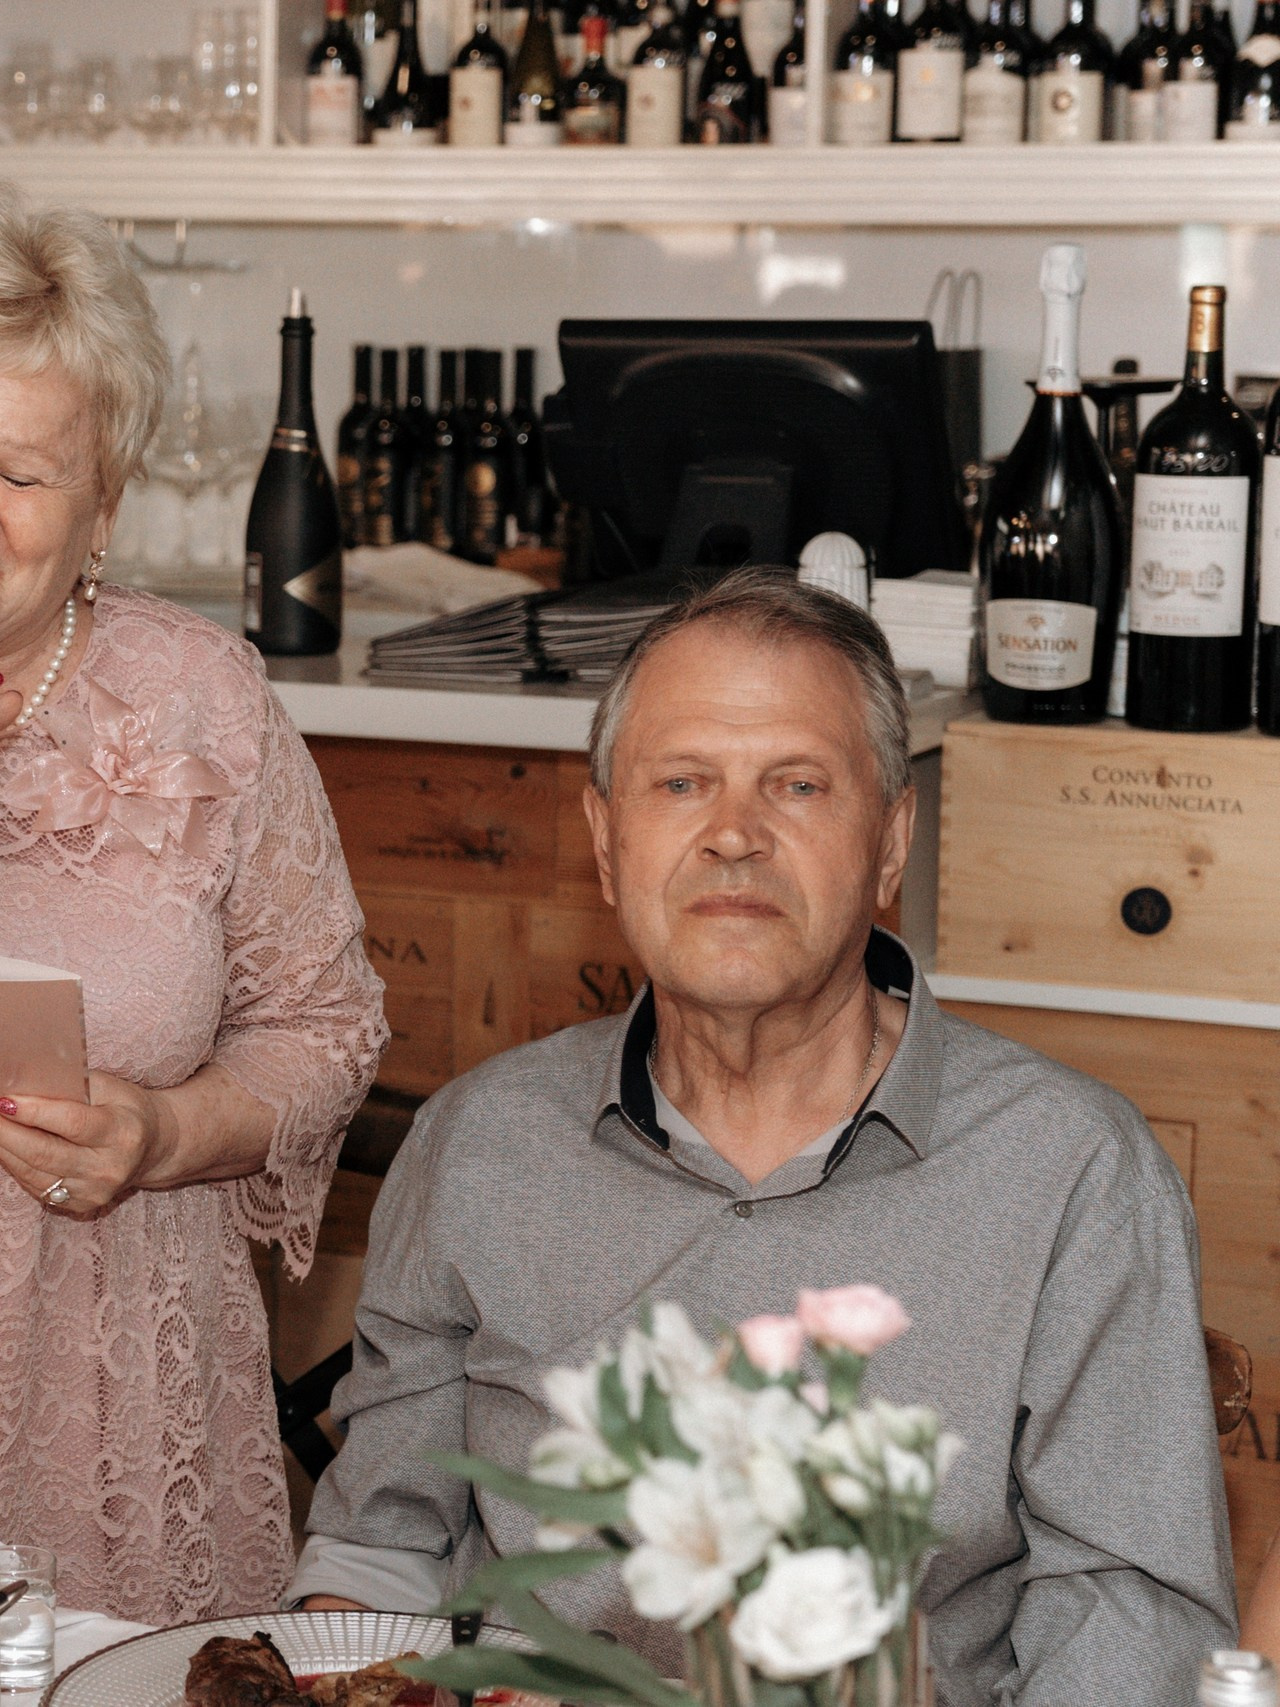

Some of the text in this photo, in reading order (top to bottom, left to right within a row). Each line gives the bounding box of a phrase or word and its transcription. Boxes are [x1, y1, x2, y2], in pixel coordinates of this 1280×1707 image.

[998, 633, 1079, 653] SENSATION
[1092, 765, 1213, 790] CONVNTO
[1105, 789, 1243, 814] ANNUNCIATA
